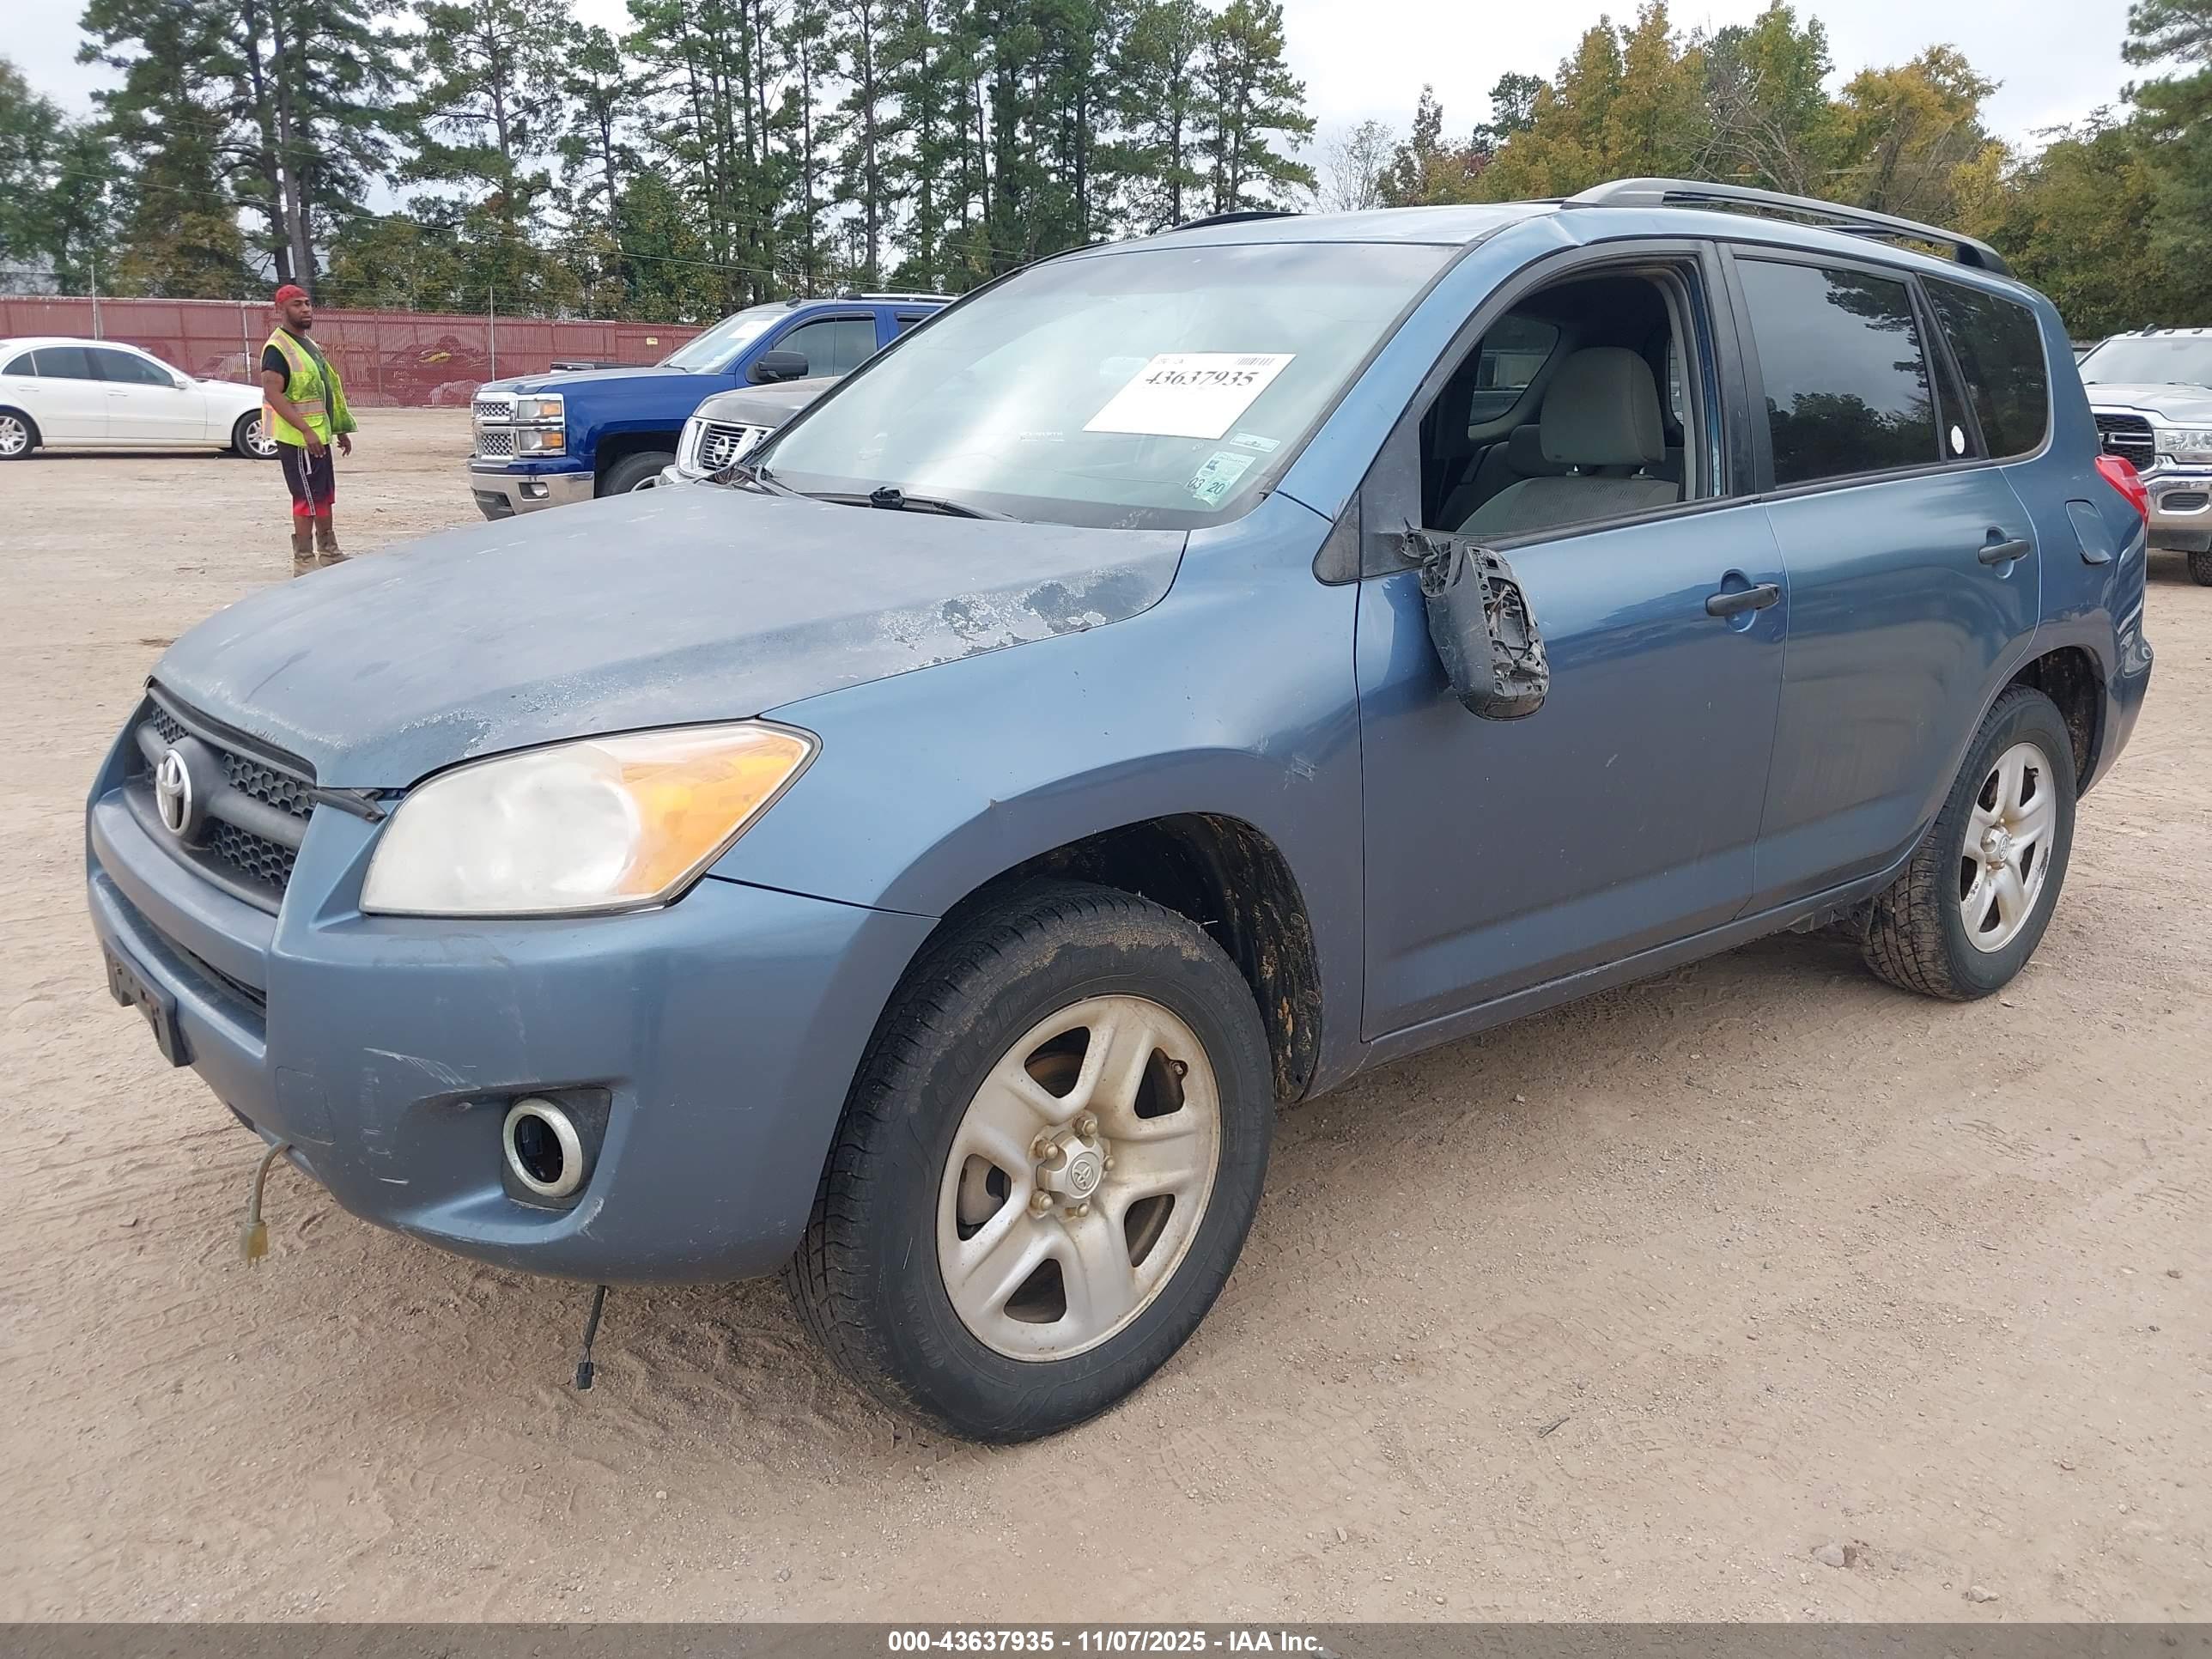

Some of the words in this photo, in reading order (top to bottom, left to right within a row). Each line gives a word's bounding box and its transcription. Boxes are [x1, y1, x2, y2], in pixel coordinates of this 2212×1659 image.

[1146, 370, 1260, 386] 43637935
[1188, 477, 1206, 489] 03
[1206, 481, 1226, 495] 20
